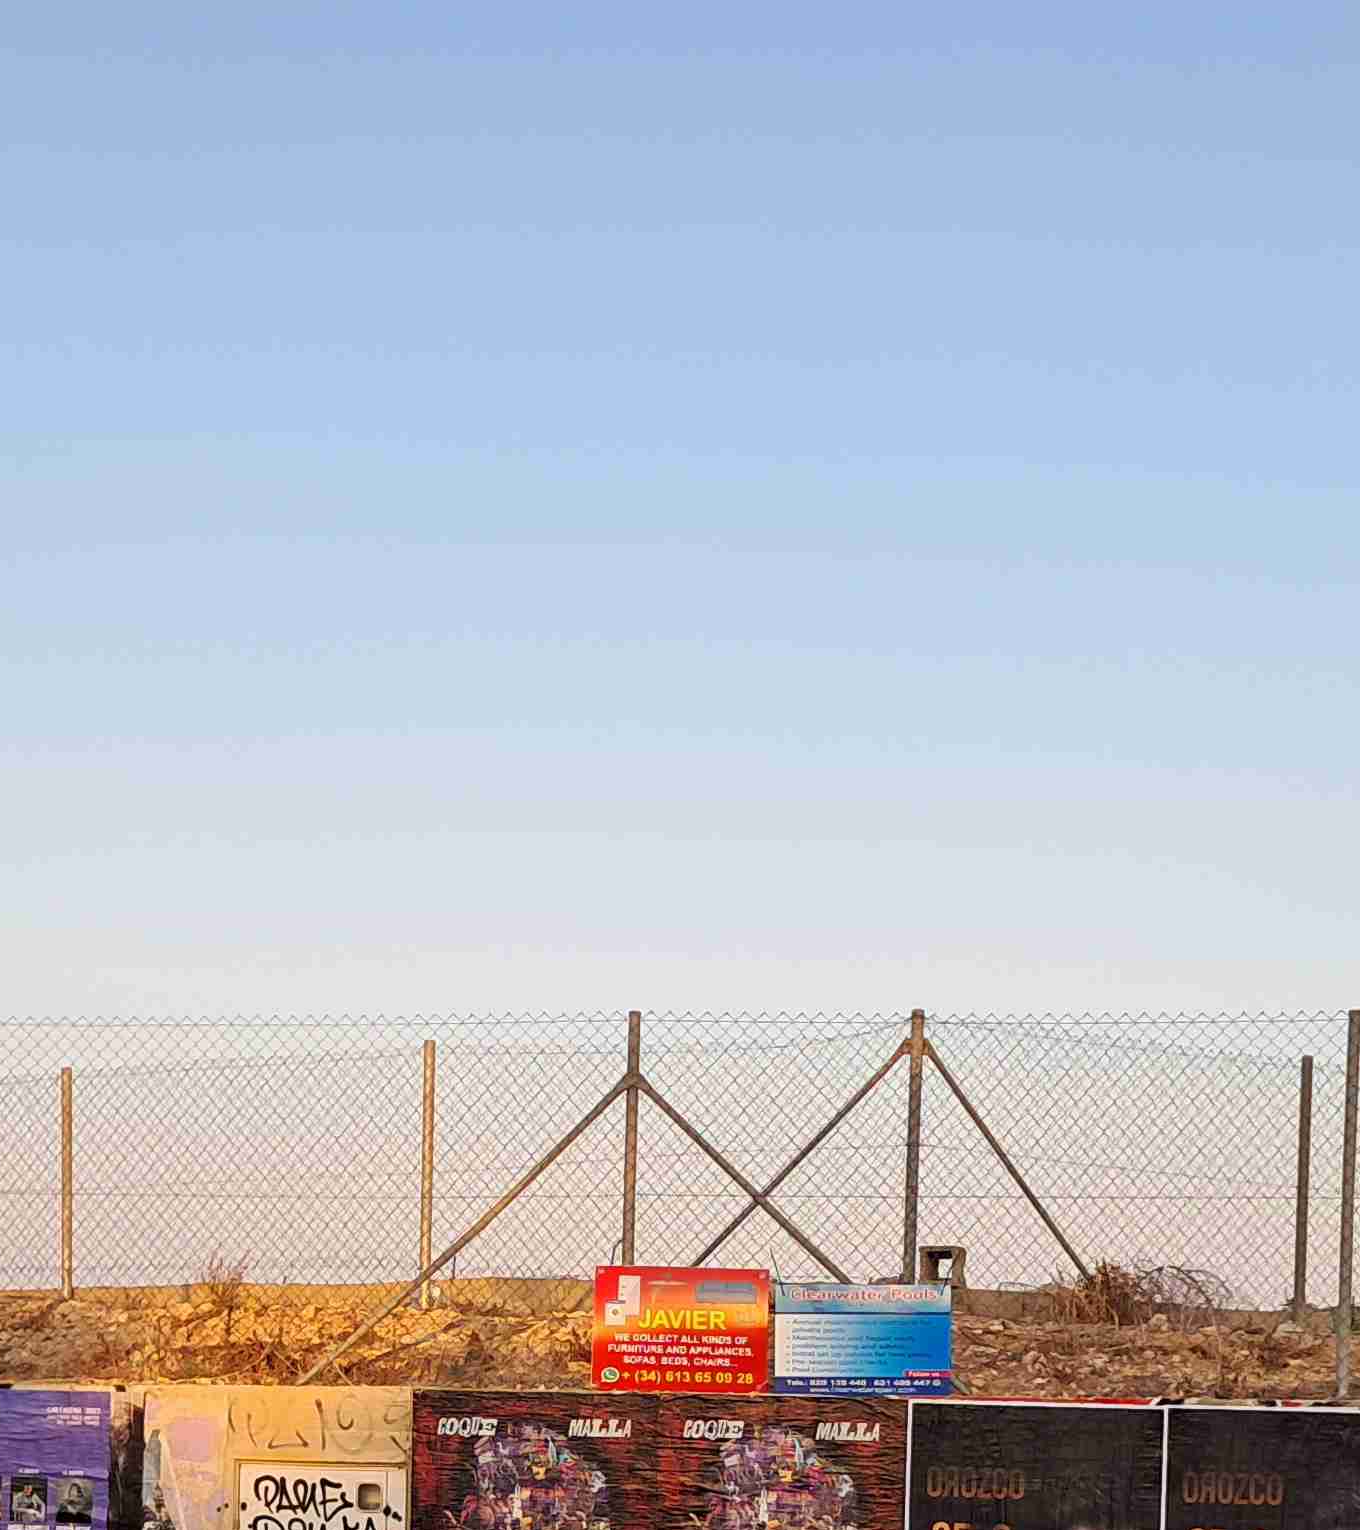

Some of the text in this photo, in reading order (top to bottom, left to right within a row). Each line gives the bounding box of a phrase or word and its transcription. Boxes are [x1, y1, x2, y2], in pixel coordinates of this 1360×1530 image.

[791, 1288, 938, 1301] Clearwater Pools
[639, 1308, 727, 1330] JAVIER
[608, 1344, 663, 1353] FURNITURE
[666, 1345, 687, 1355] AND
[614, 1333, 748, 1345] WE COLLECT ALL KINDS OF
[634, 1369, 661, 1384] (34)
[694, 1371, 712, 1384] 65
[715, 1372, 733, 1384] 09
[736, 1372, 753, 1384] 28
[436, 1416, 632, 1439] COQUE MALLA
[815, 1420, 881, 1442] MALLA
[926, 1466, 1025, 1500] OROZCO
[1183, 1471, 1283, 1505] OROZCO
